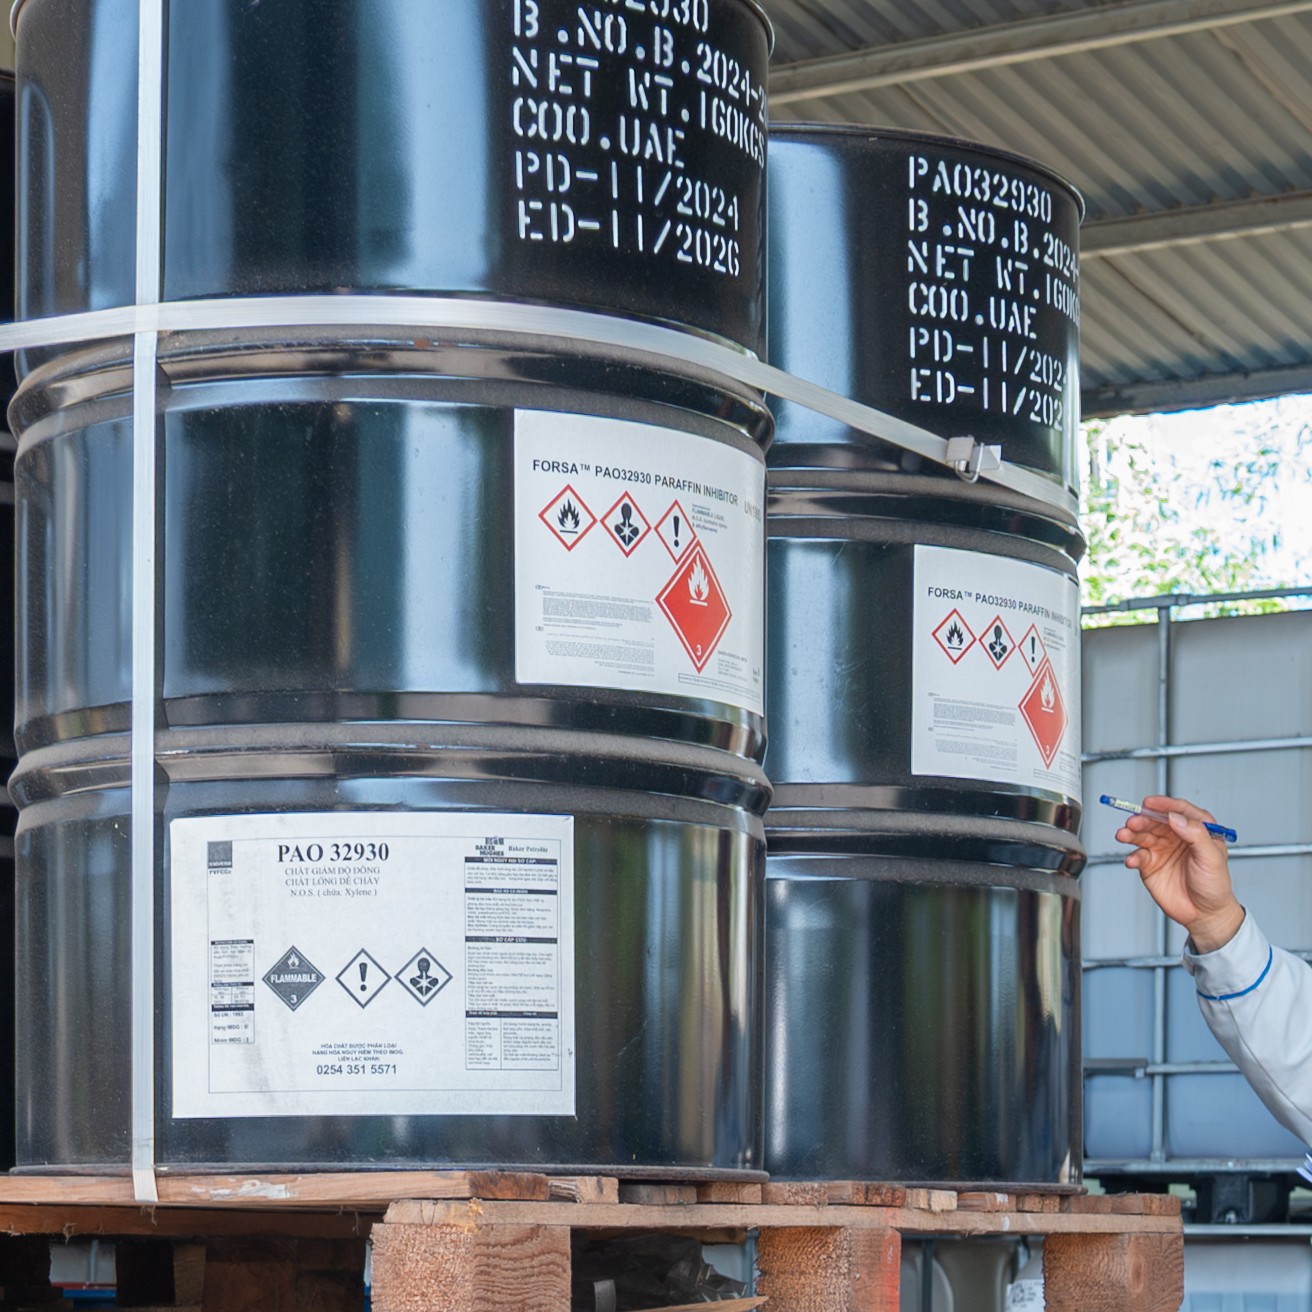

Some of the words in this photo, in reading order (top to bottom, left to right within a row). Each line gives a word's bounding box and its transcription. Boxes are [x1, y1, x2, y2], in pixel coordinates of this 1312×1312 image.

[513, 46, 598, 97] NET
[513, 97, 684, 168] COO.UAE
[516, 150, 738, 231] PD-11/2024
[519, 200, 739, 276] ED-11/2026
[908, 240, 974, 281] NET
[909, 282, 1036, 339] COO.UAE
[911, 368, 1063, 431] ED-11/202
[595, 466, 651, 484] PAO32930
[655, 475, 701, 495] PARAFFIN
[704, 484, 738, 505] INHIBITOR
[976, 593, 1016, 610] PAO32930
[1019, 601, 1050, 619] PARAFFIN
[696, 644, 703, 656] 3
[278, 843, 323, 863] PAO
[330, 842, 389, 862] 32930
[271, 973, 317, 983] FLAMMABLE
[291, 995, 297, 1003] 3
[317, 1065, 343, 1075] 0254
[347, 1064, 366, 1075] 351
[371, 1064, 397, 1075] 5571
